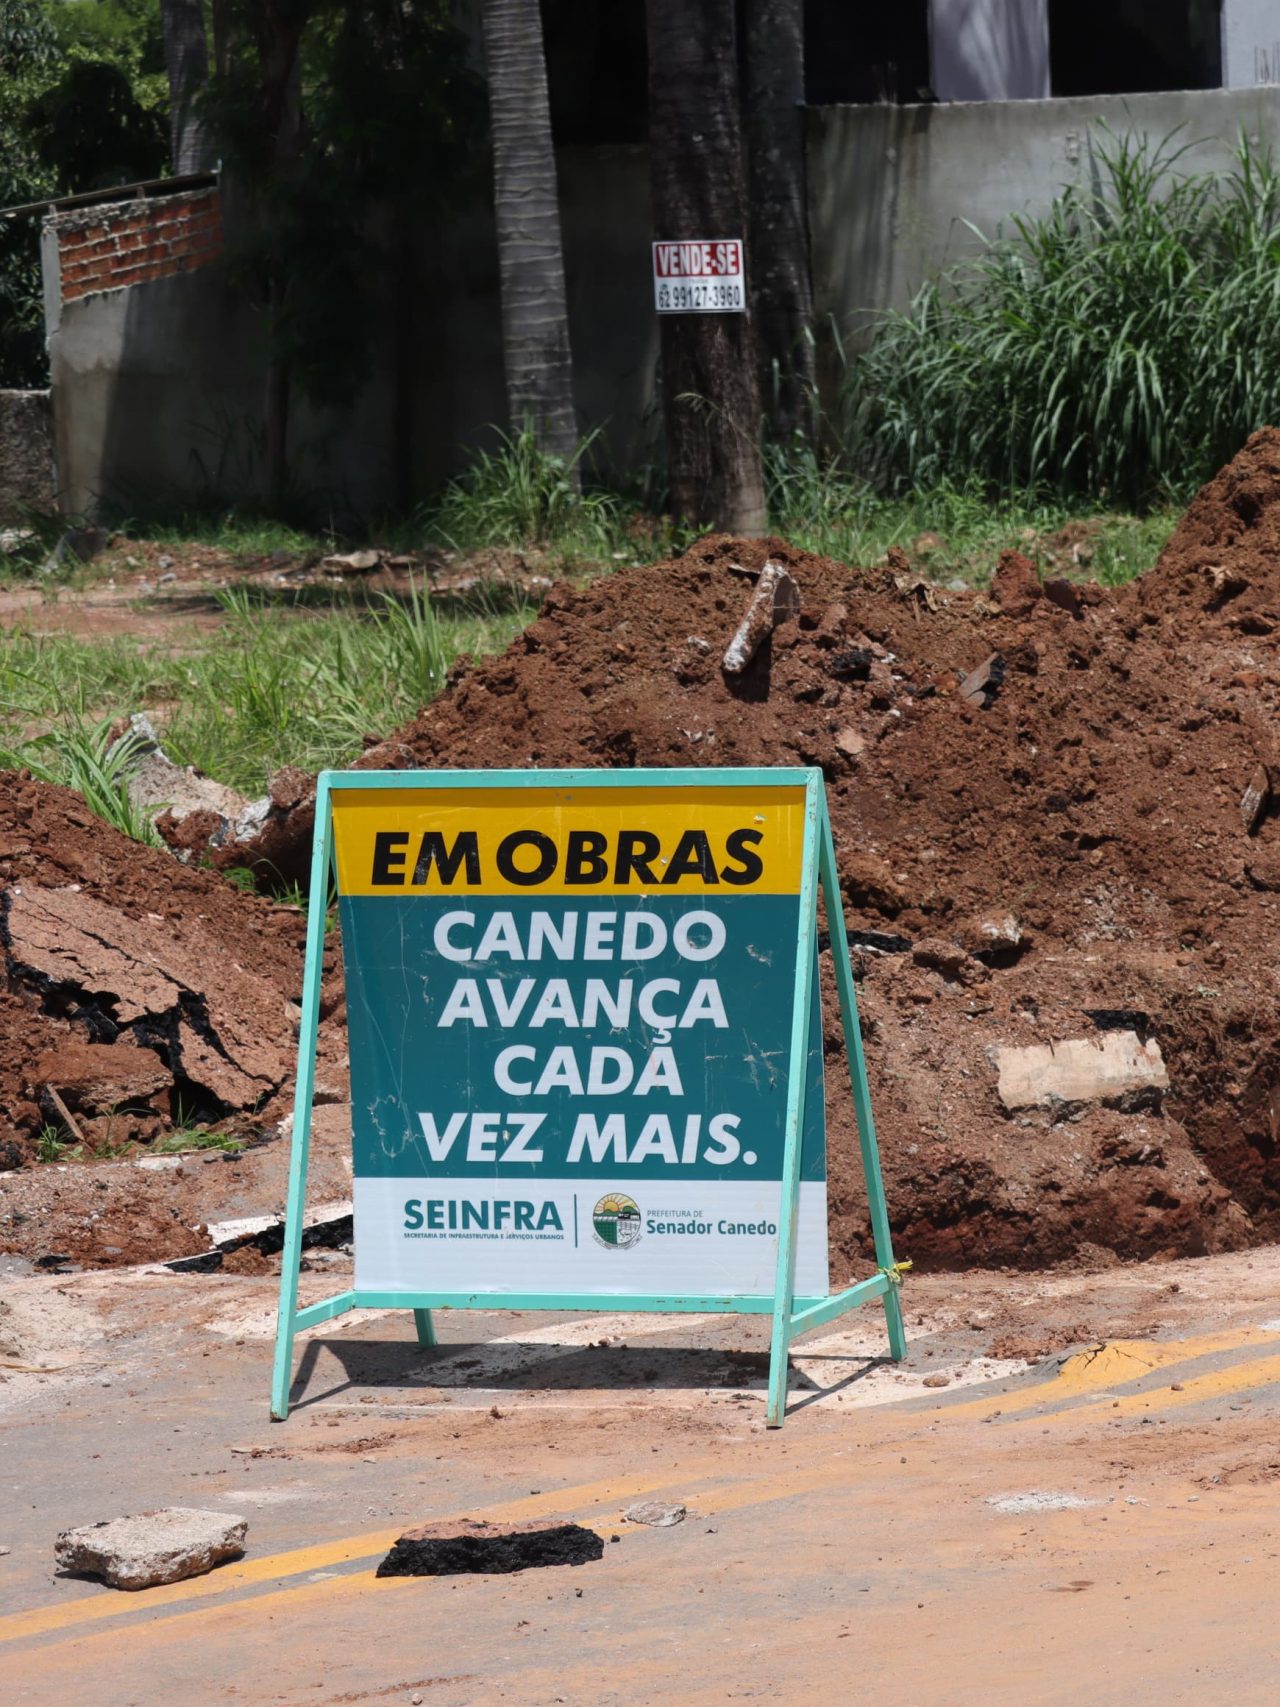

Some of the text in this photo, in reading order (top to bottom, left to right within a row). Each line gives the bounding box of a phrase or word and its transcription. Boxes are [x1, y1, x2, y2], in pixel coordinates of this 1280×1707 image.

[658, 244, 738, 275] VENDE-SE
[673, 285, 740, 307] 99127-3960
[371, 828, 765, 886] EM OBRAS
[433, 910, 727, 962] CANEDO
[437, 977, 729, 1044] AVANÇA
[493, 1045, 685, 1096] CADA
[418, 1112, 758, 1165] VEZ MAIS.
[404, 1199, 564, 1230] SEINFRA
[646, 1219, 777, 1236] Senador Canedo
[647, 1210, 704, 1218] PREFEITURA DE
